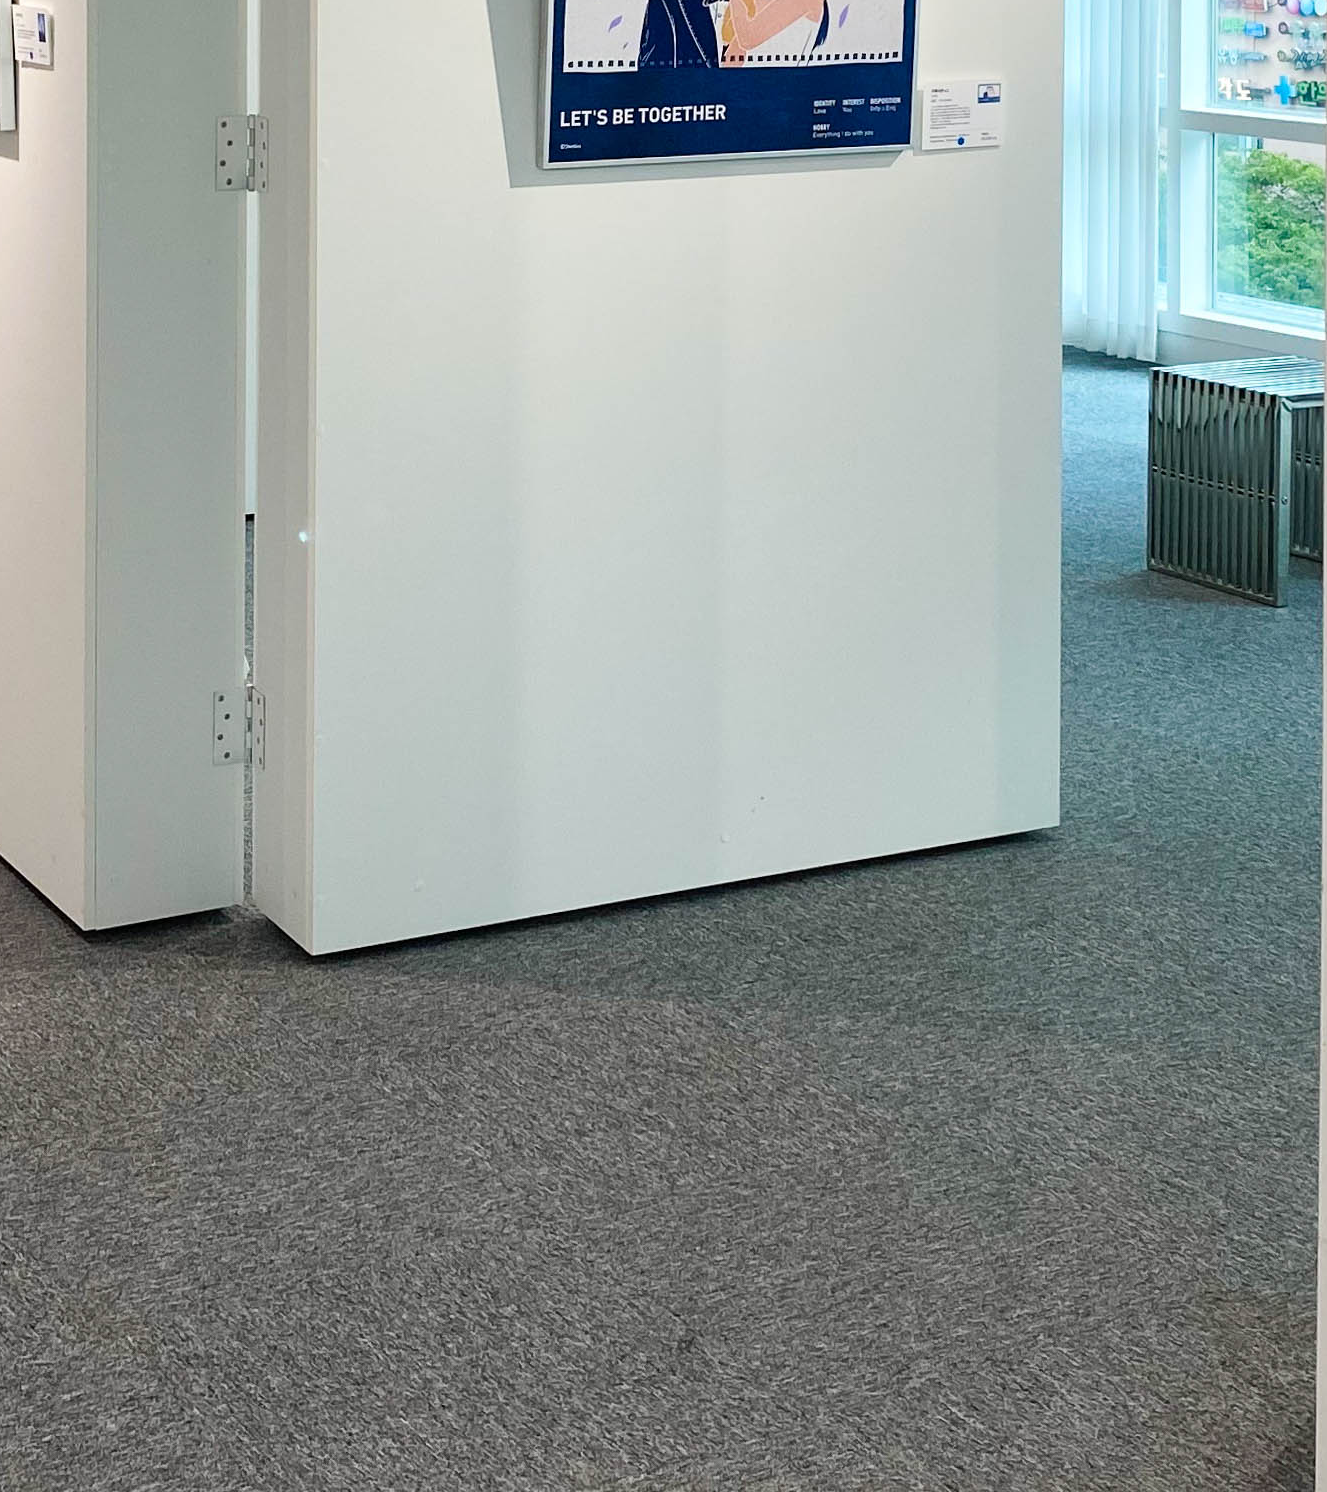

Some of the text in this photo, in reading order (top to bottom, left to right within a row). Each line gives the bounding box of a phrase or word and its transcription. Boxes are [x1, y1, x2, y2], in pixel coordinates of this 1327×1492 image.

[560, 104, 726, 127] LET'S BE TOGETHER
